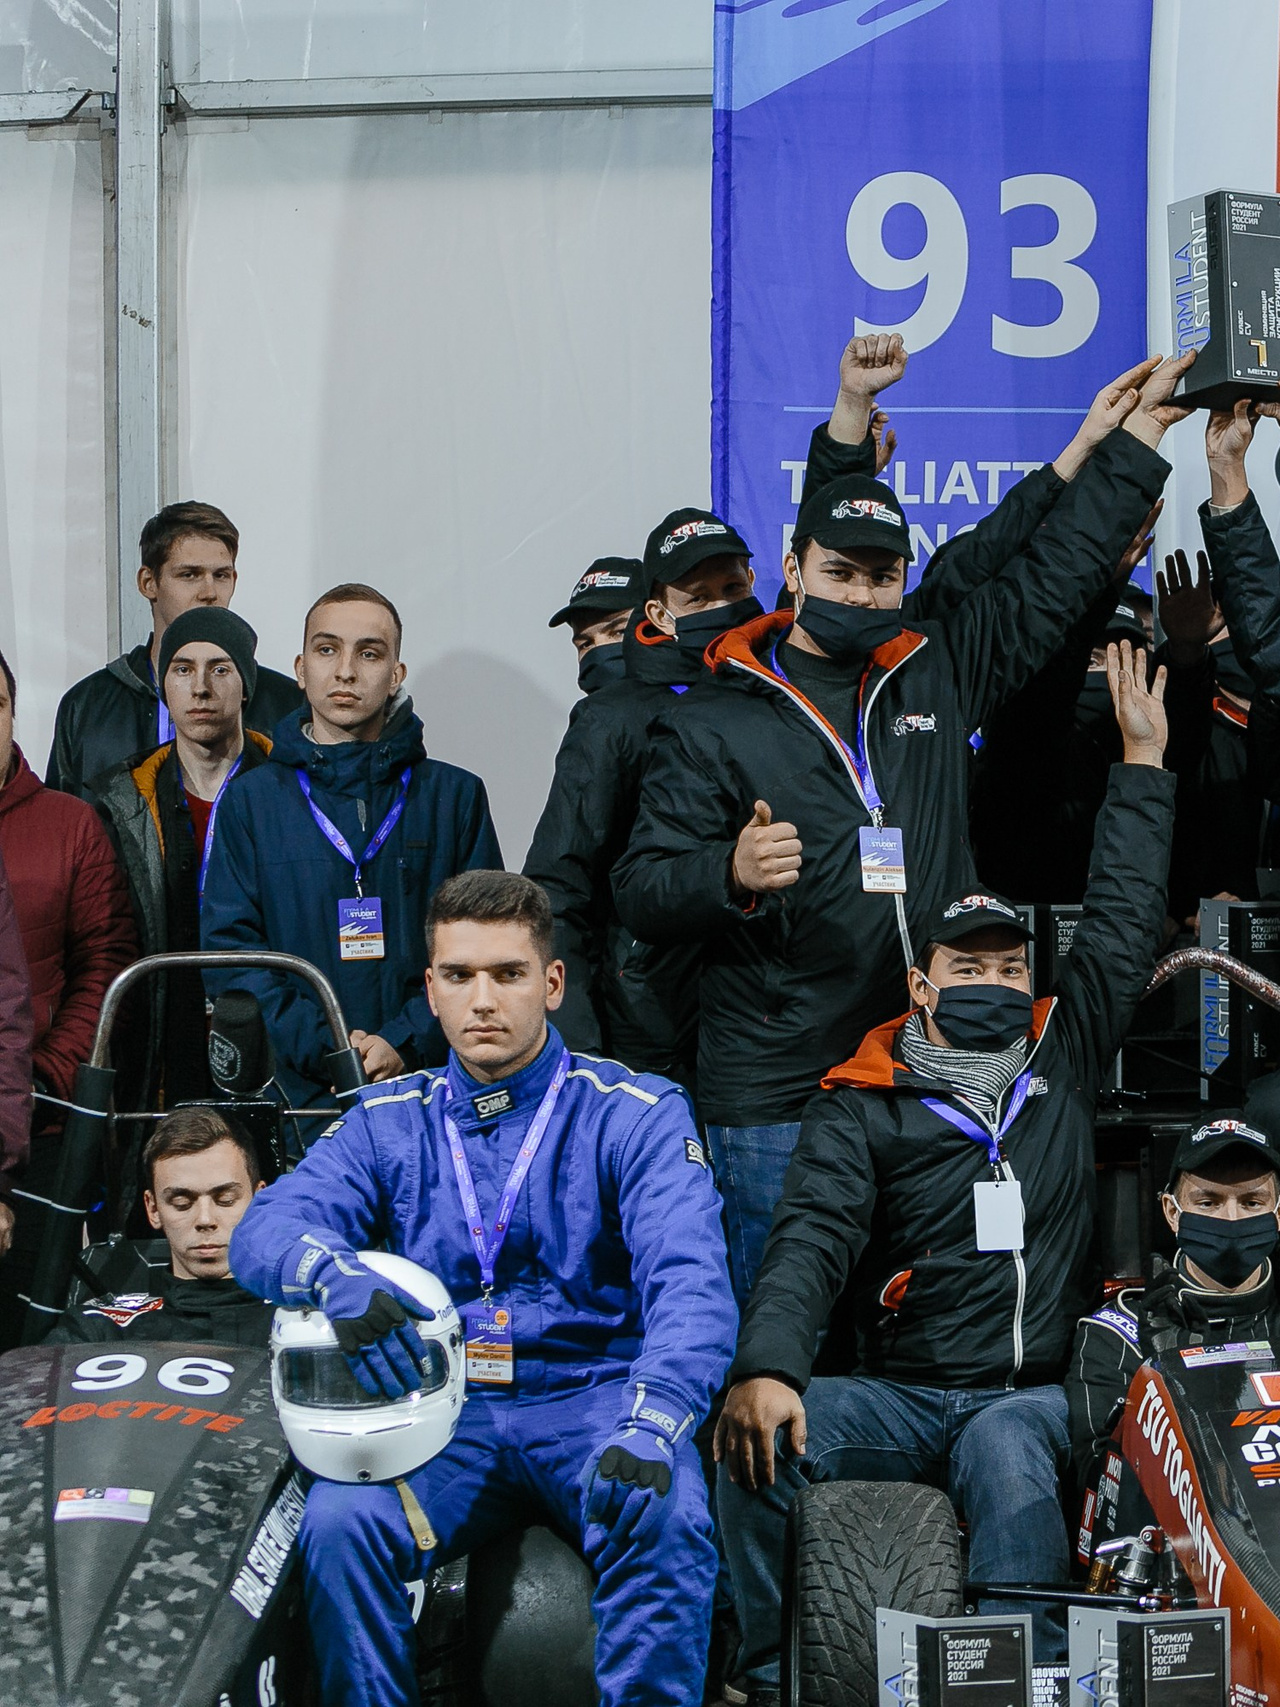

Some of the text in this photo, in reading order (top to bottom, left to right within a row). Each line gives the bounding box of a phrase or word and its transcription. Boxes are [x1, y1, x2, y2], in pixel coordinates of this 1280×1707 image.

[1230, 200, 1263, 211] ФОРМУЛА
[1231, 208, 1261, 218] СТУДЕНТ
[1231, 215, 1259, 225] РОССИЯ
[1232, 223, 1247, 231] 2021
[845, 171, 1101, 359] 93
[1251, 933, 1279, 941] РОССИЯ
[1057, 944, 1073, 952] 202
[1251, 941, 1266, 949] 2021
[476, 1094, 511, 1115] OMP
[71, 1353, 235, 1396] 96
[21, 1400, 246, 1433] LOCTITE
[1136, 1379, 1227, 1608] TSU TOGLIATTI
[1151, 1631, 1194, 1644] ФОРМУЛА
[946, 1638, 991, 1650] ФОРМУЛА
[1151, 1642, 1190, 1655] СТУДЕНТ
[946, 1649, 989, 1660] СТУДЕНТ
[1151, 1653, 1187, 1665] РОССИЯ
[947, 1659, 985, 1671] РОССИЯ
[1151, 1664, 1171, 1676] 2021
[947, 1671, 968, 1682] 2021
